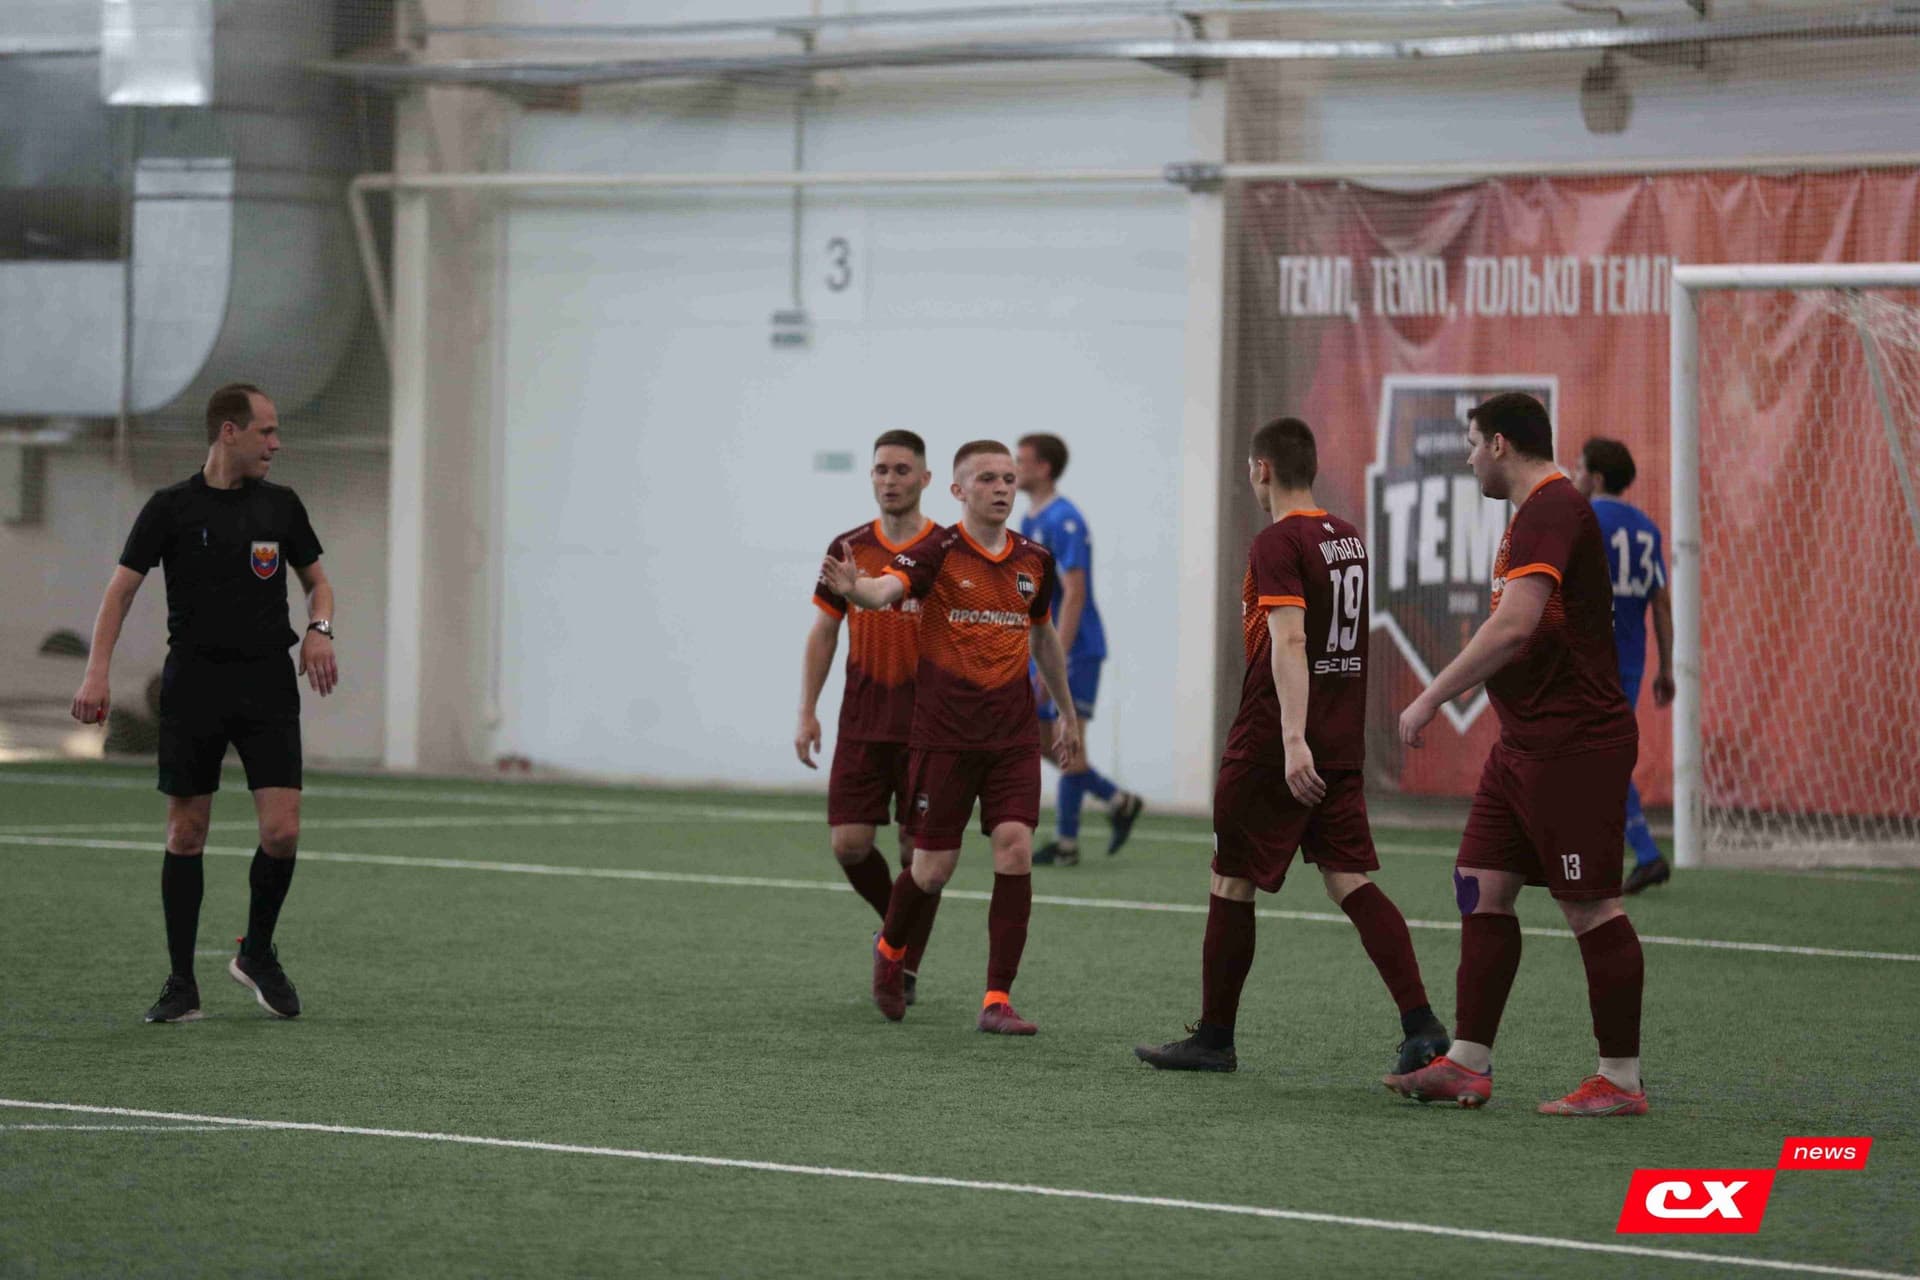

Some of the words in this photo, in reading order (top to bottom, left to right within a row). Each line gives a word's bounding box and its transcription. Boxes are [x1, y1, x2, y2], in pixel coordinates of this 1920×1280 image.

[826, 237, 851, 292] 3
[1278, 256, 1360, 321] ТЕМП,
[1464, 256, 1580, 314] ТОЛЬКО
[1384, 474, 1517, 591] ТЕМ
[1611, 526, 1654, 597] 13
[1326, 564, 1364, 653] 19
[1560, 853, 1581, 881] 13
